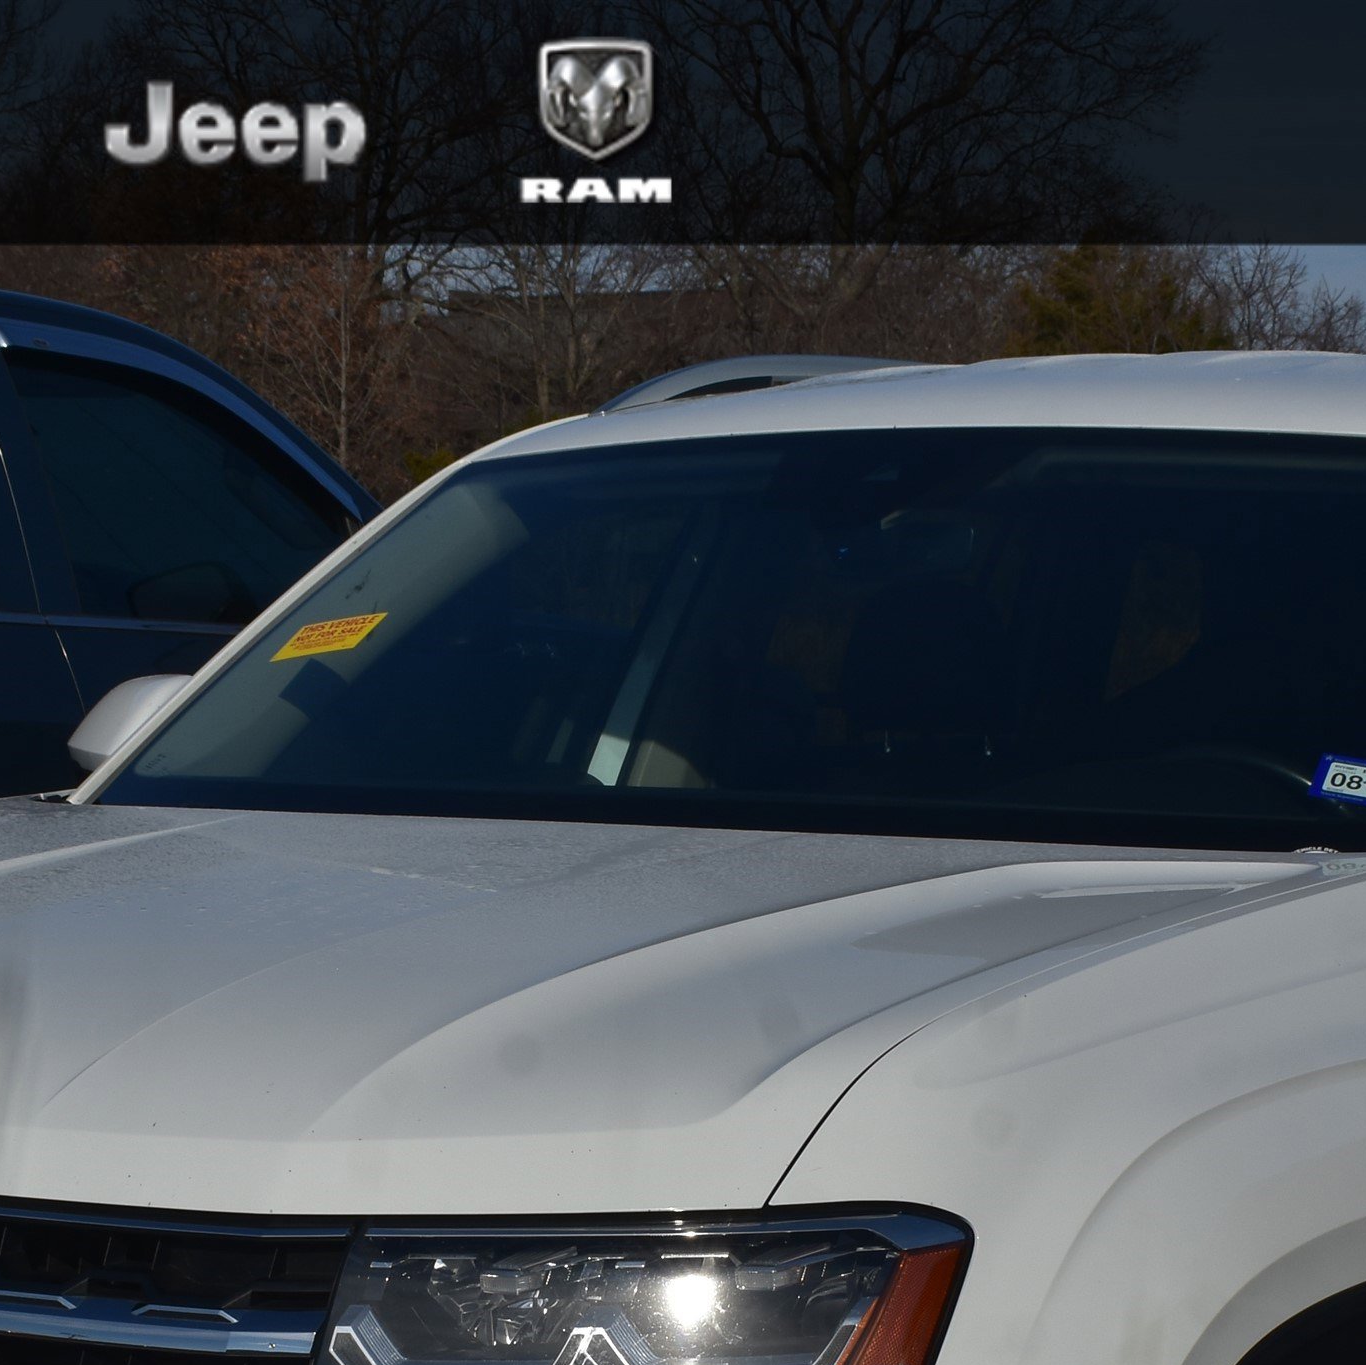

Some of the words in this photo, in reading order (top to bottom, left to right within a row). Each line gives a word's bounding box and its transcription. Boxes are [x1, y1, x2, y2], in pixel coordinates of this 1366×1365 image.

[301, 623, 327, 635] THIS
[329, 615, 380, 631] VEHICLE
[339, 625, 368, 636] SALE
[1330, 772, 1363, 790] 08
